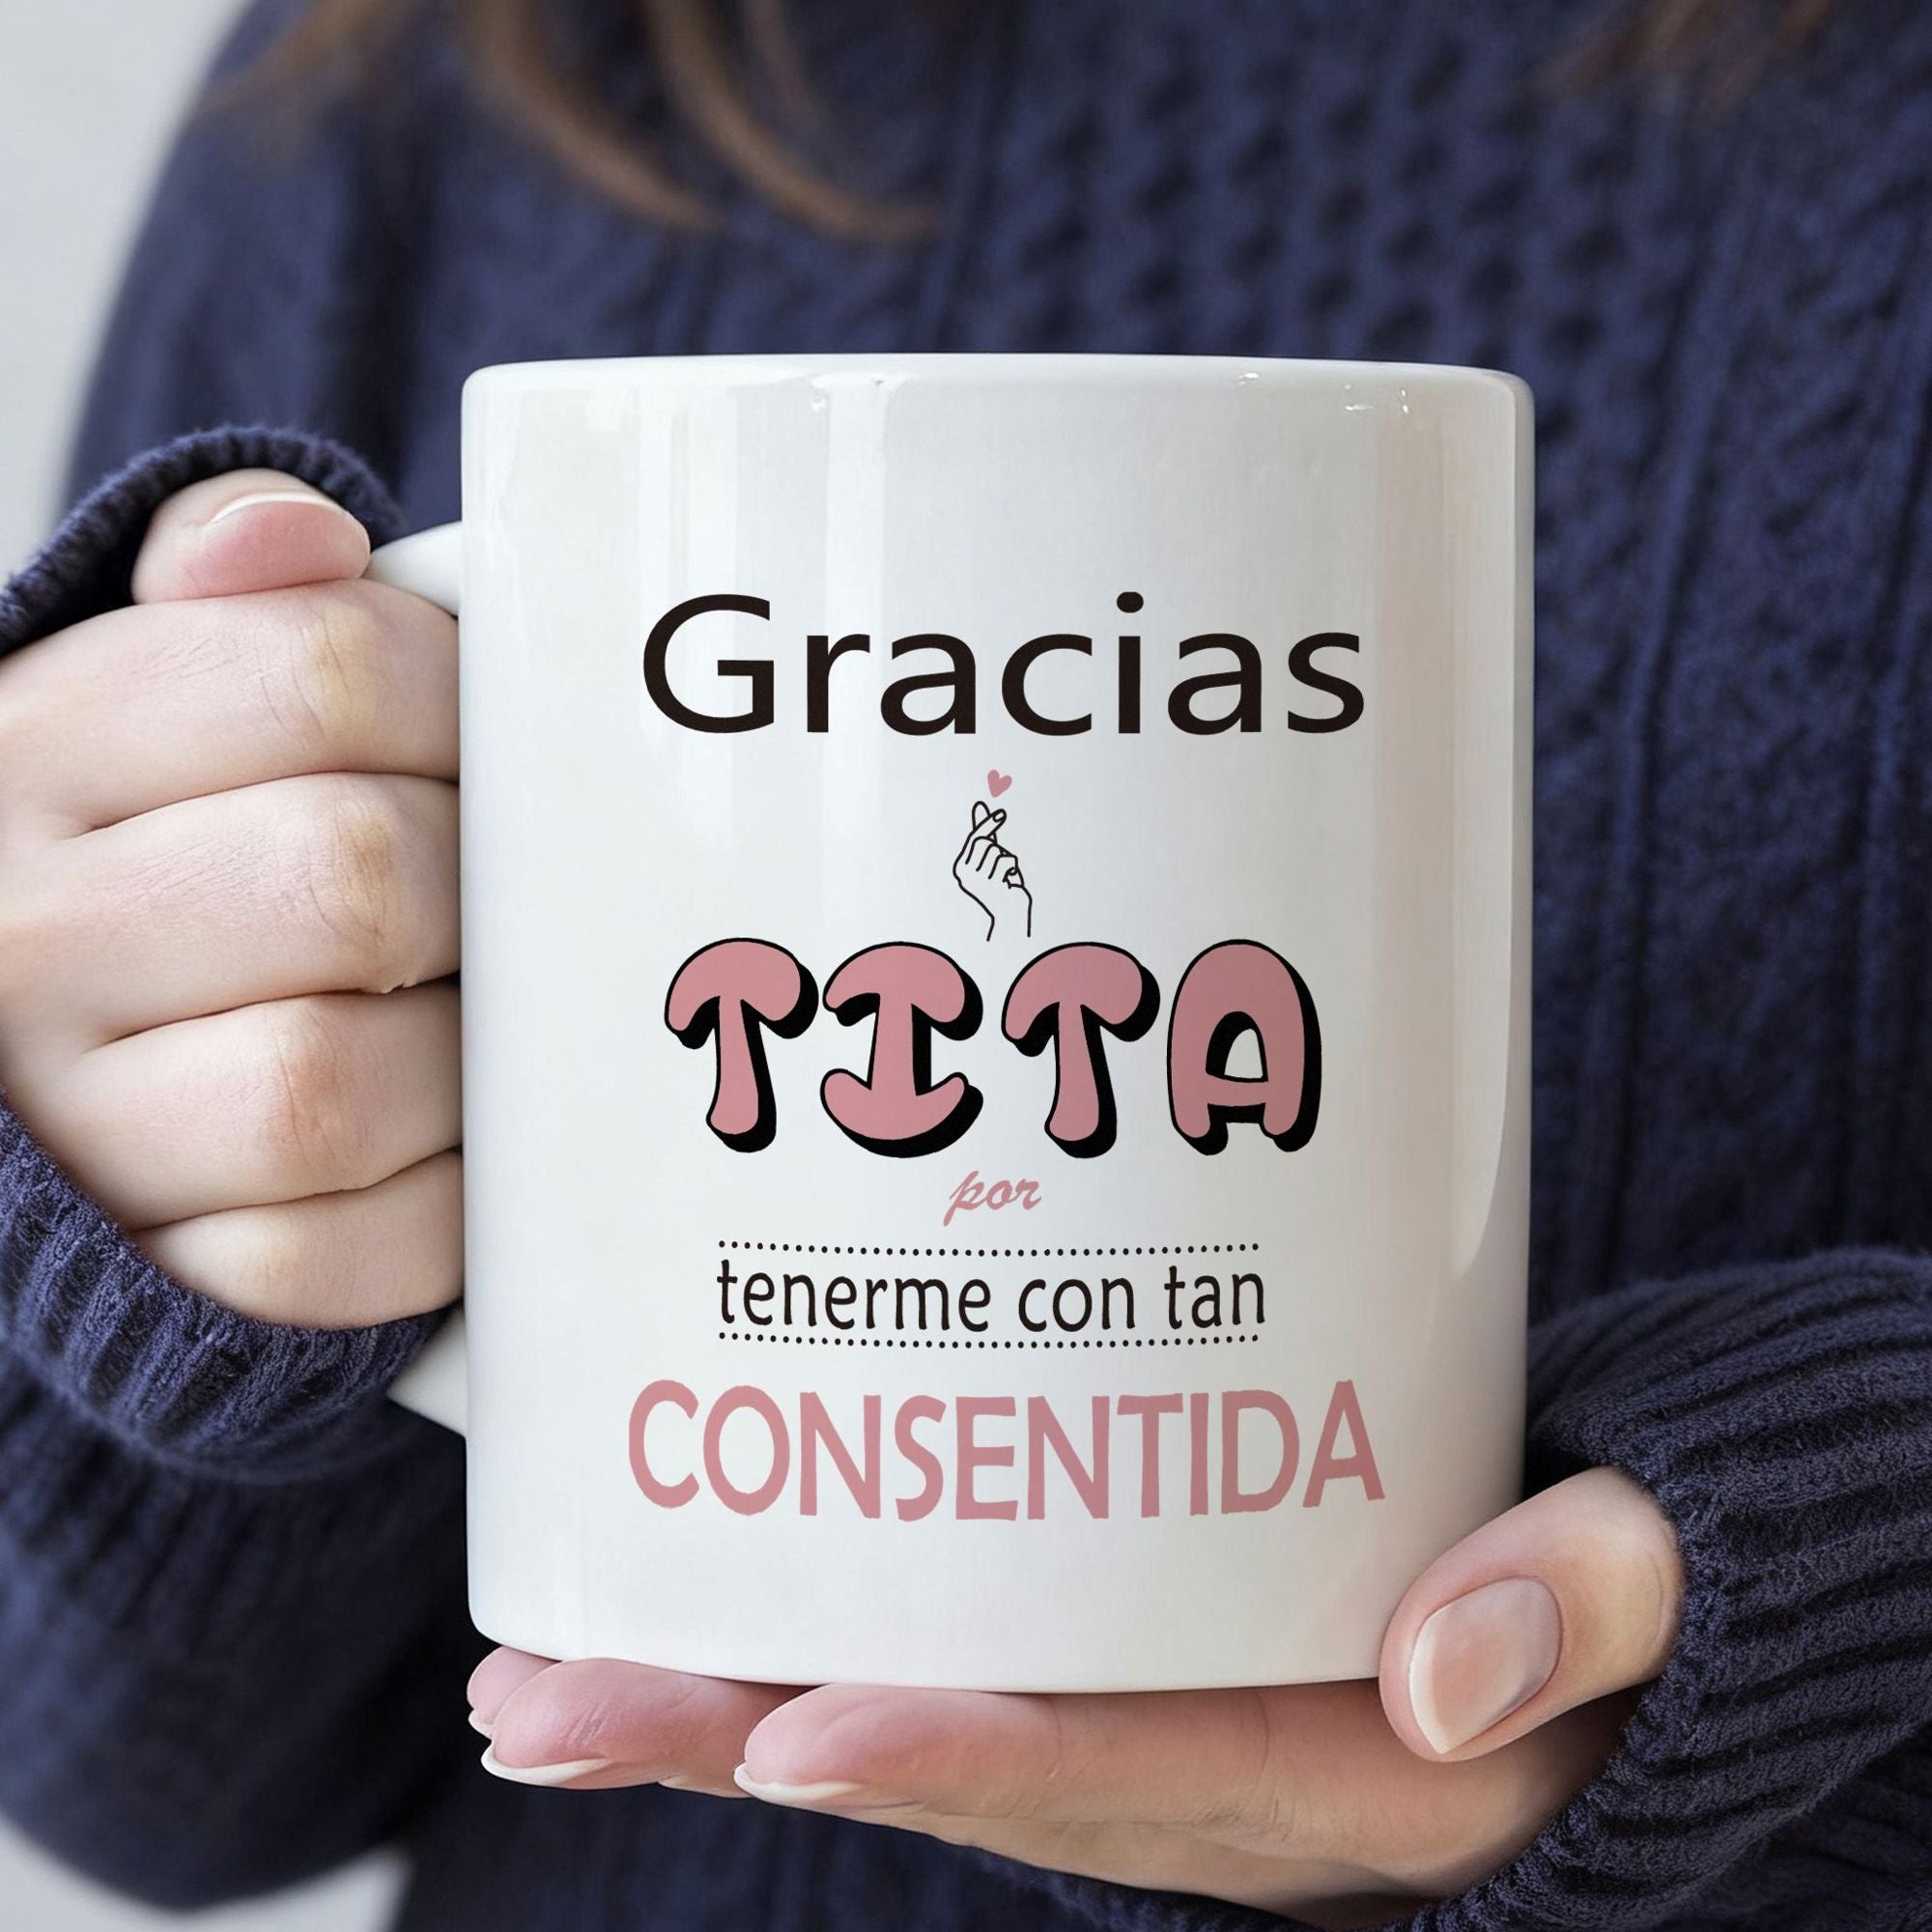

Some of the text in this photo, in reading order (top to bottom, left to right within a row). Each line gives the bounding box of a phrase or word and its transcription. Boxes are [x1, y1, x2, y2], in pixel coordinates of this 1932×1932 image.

[642, 591, 1365, 737] Gracias
[664, 937, 1322, 1159] TITA
[943, 1170, 1042, 1227] por
[718, 1259, 1266, 1333] tenerme con tan
[629, 1378, 1386, 1522] CONSENTIDA
